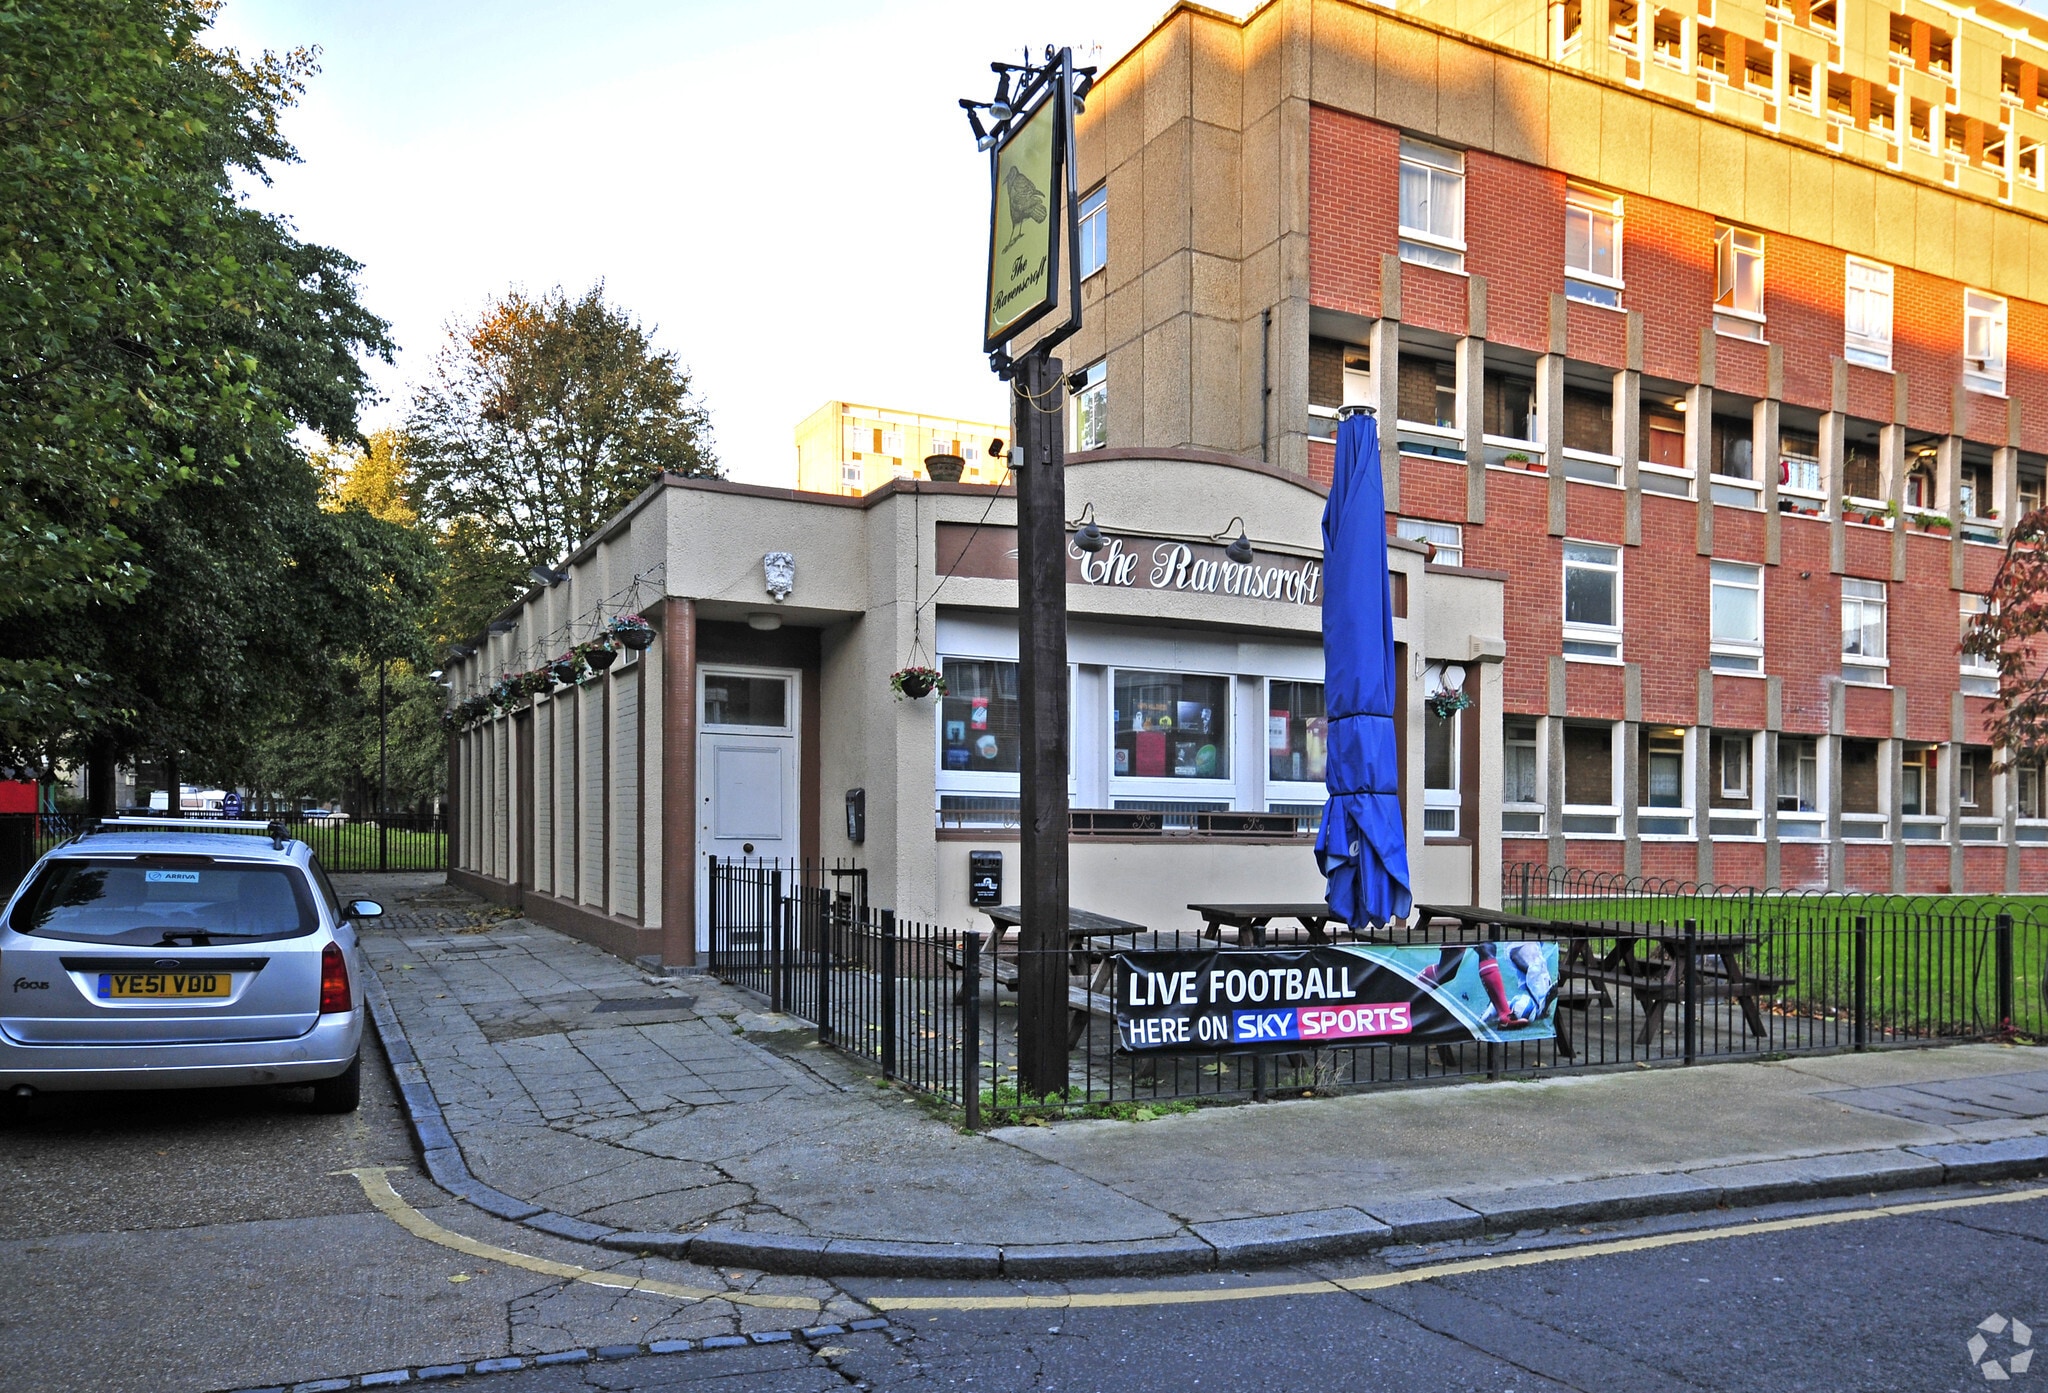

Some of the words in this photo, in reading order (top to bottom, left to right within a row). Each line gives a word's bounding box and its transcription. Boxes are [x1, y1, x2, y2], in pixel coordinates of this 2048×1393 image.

[992, 256, 1046, 314] Ravenscroft
[1011, 255, 1027, 281] The
[1068, 537, 1139, 586] The
[1150, 542, 1320, 605] Ravenscroft
[114, 974, 166, 993] YE51
[1129, 970, 1198, 1006] LIVE
[1209, 966, 1356, 1003] FOOTBALL
[1129, 1016, 1192, 1044] HERE
[1198, 1015, 1228, 1041] ON
[1237, 1012, 1294, 1039] SKY
[1302, 1007, 1409, 1035] SPORTS
